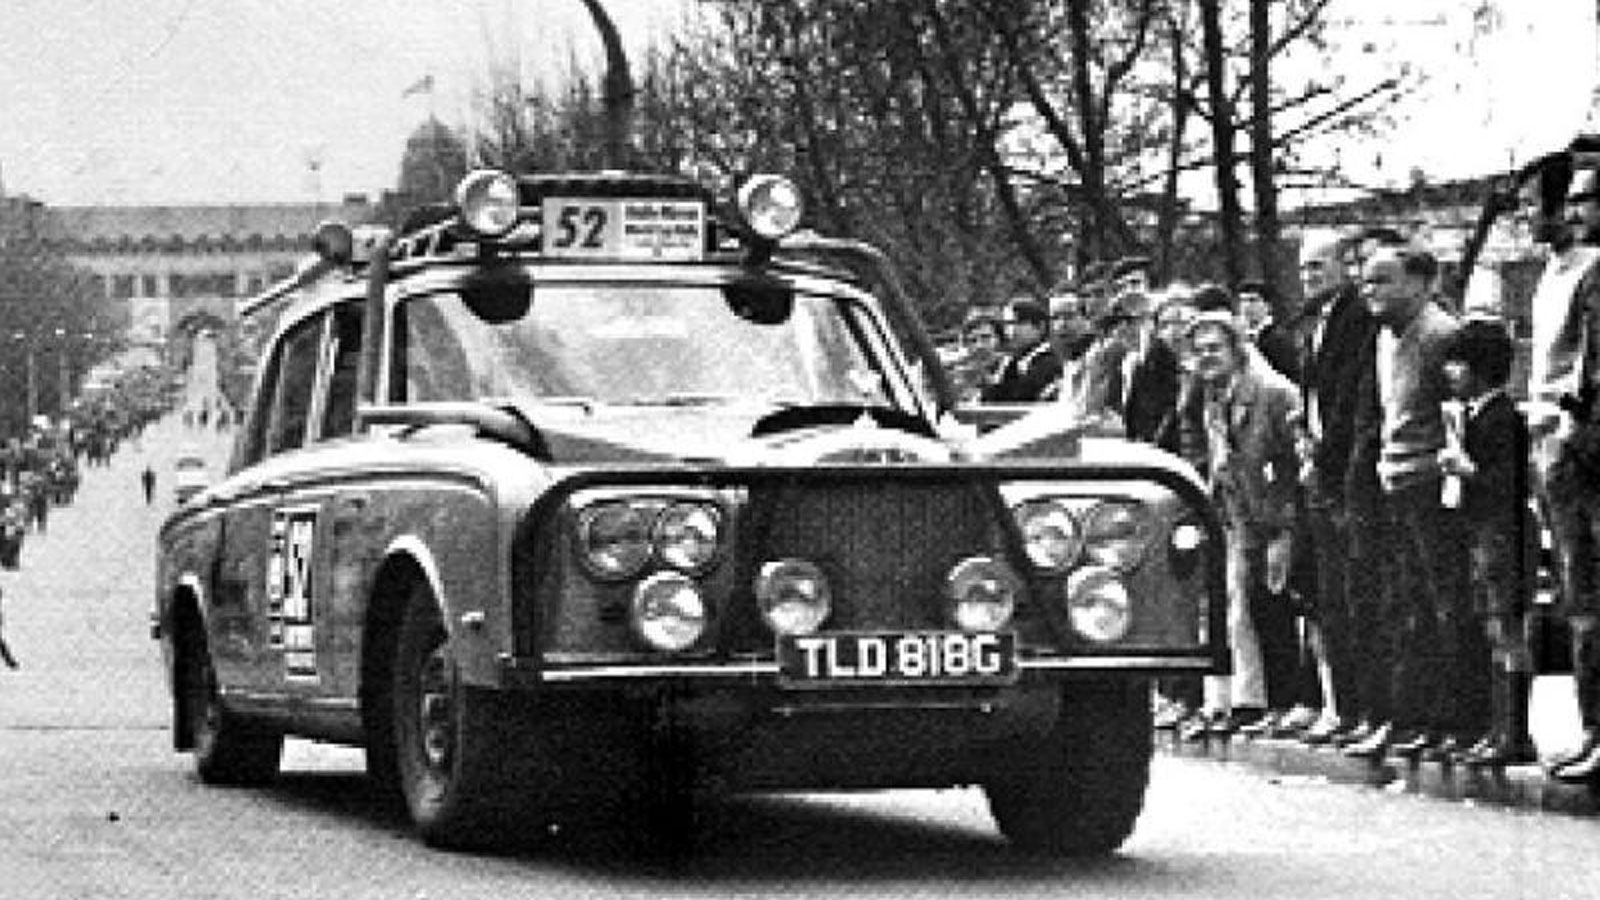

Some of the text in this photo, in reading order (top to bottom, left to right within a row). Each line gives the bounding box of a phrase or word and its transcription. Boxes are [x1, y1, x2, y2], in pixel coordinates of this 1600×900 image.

[553, 205, 607, 248] 52
[796, 634, 1001, 677] TLD 818G
